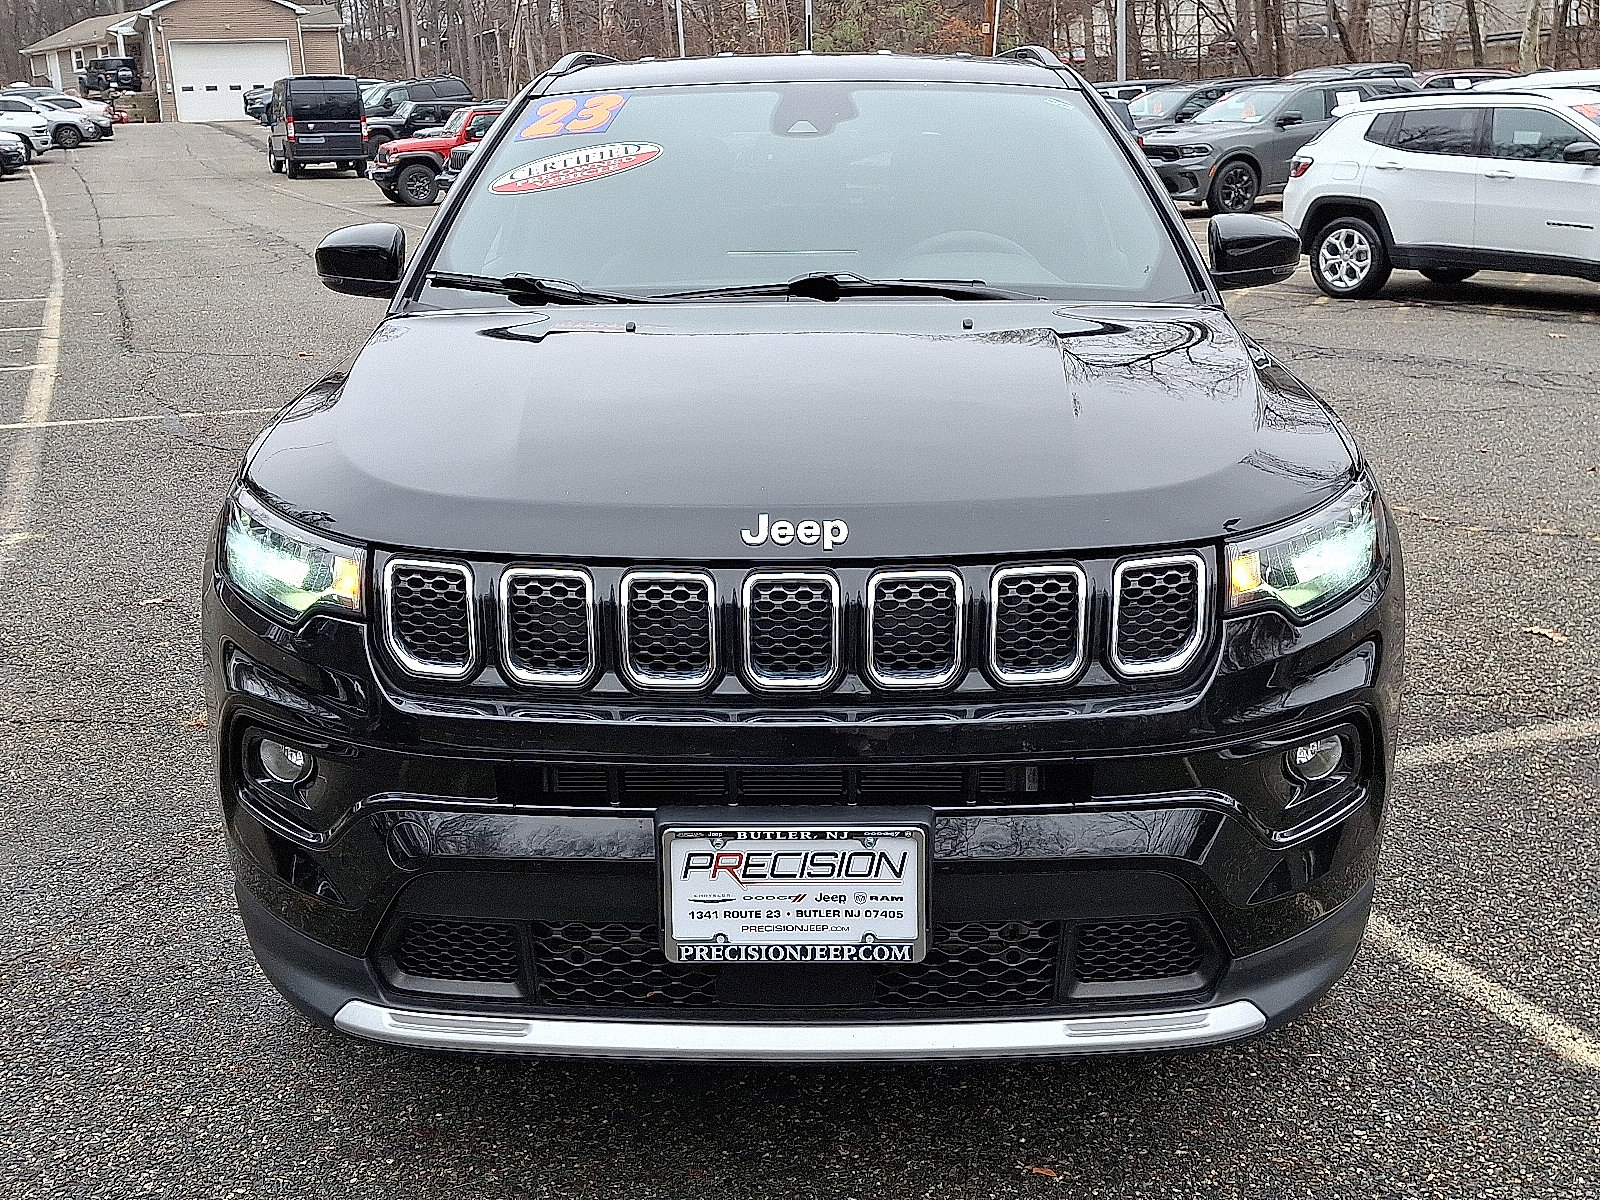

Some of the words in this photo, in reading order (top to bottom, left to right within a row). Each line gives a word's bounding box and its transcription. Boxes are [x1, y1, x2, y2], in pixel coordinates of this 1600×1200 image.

[520, 94, 626, 138] 23
[509, 143, 641, 180] CERTIFIED
[740, 512, 849, 551] Jeep
[736, 831, 818, 840] BUTLER,
[826, 831, 849, 840] NJ
[681, 851, 908, 890] PRECISION
[814, 892, 847, 905] Jeep
[688, 910, 719, 920] 1341
[723, 910, 762, 919] ROUTE
[766, 910, 781, 919] 23
[796, 909, 841, 918] BUTLER
[845, 909, 861, 918] NJ
[864, 910, 904, 919] 07405
[679, 945, 911, 961] PRECISIONJEEP.COM
